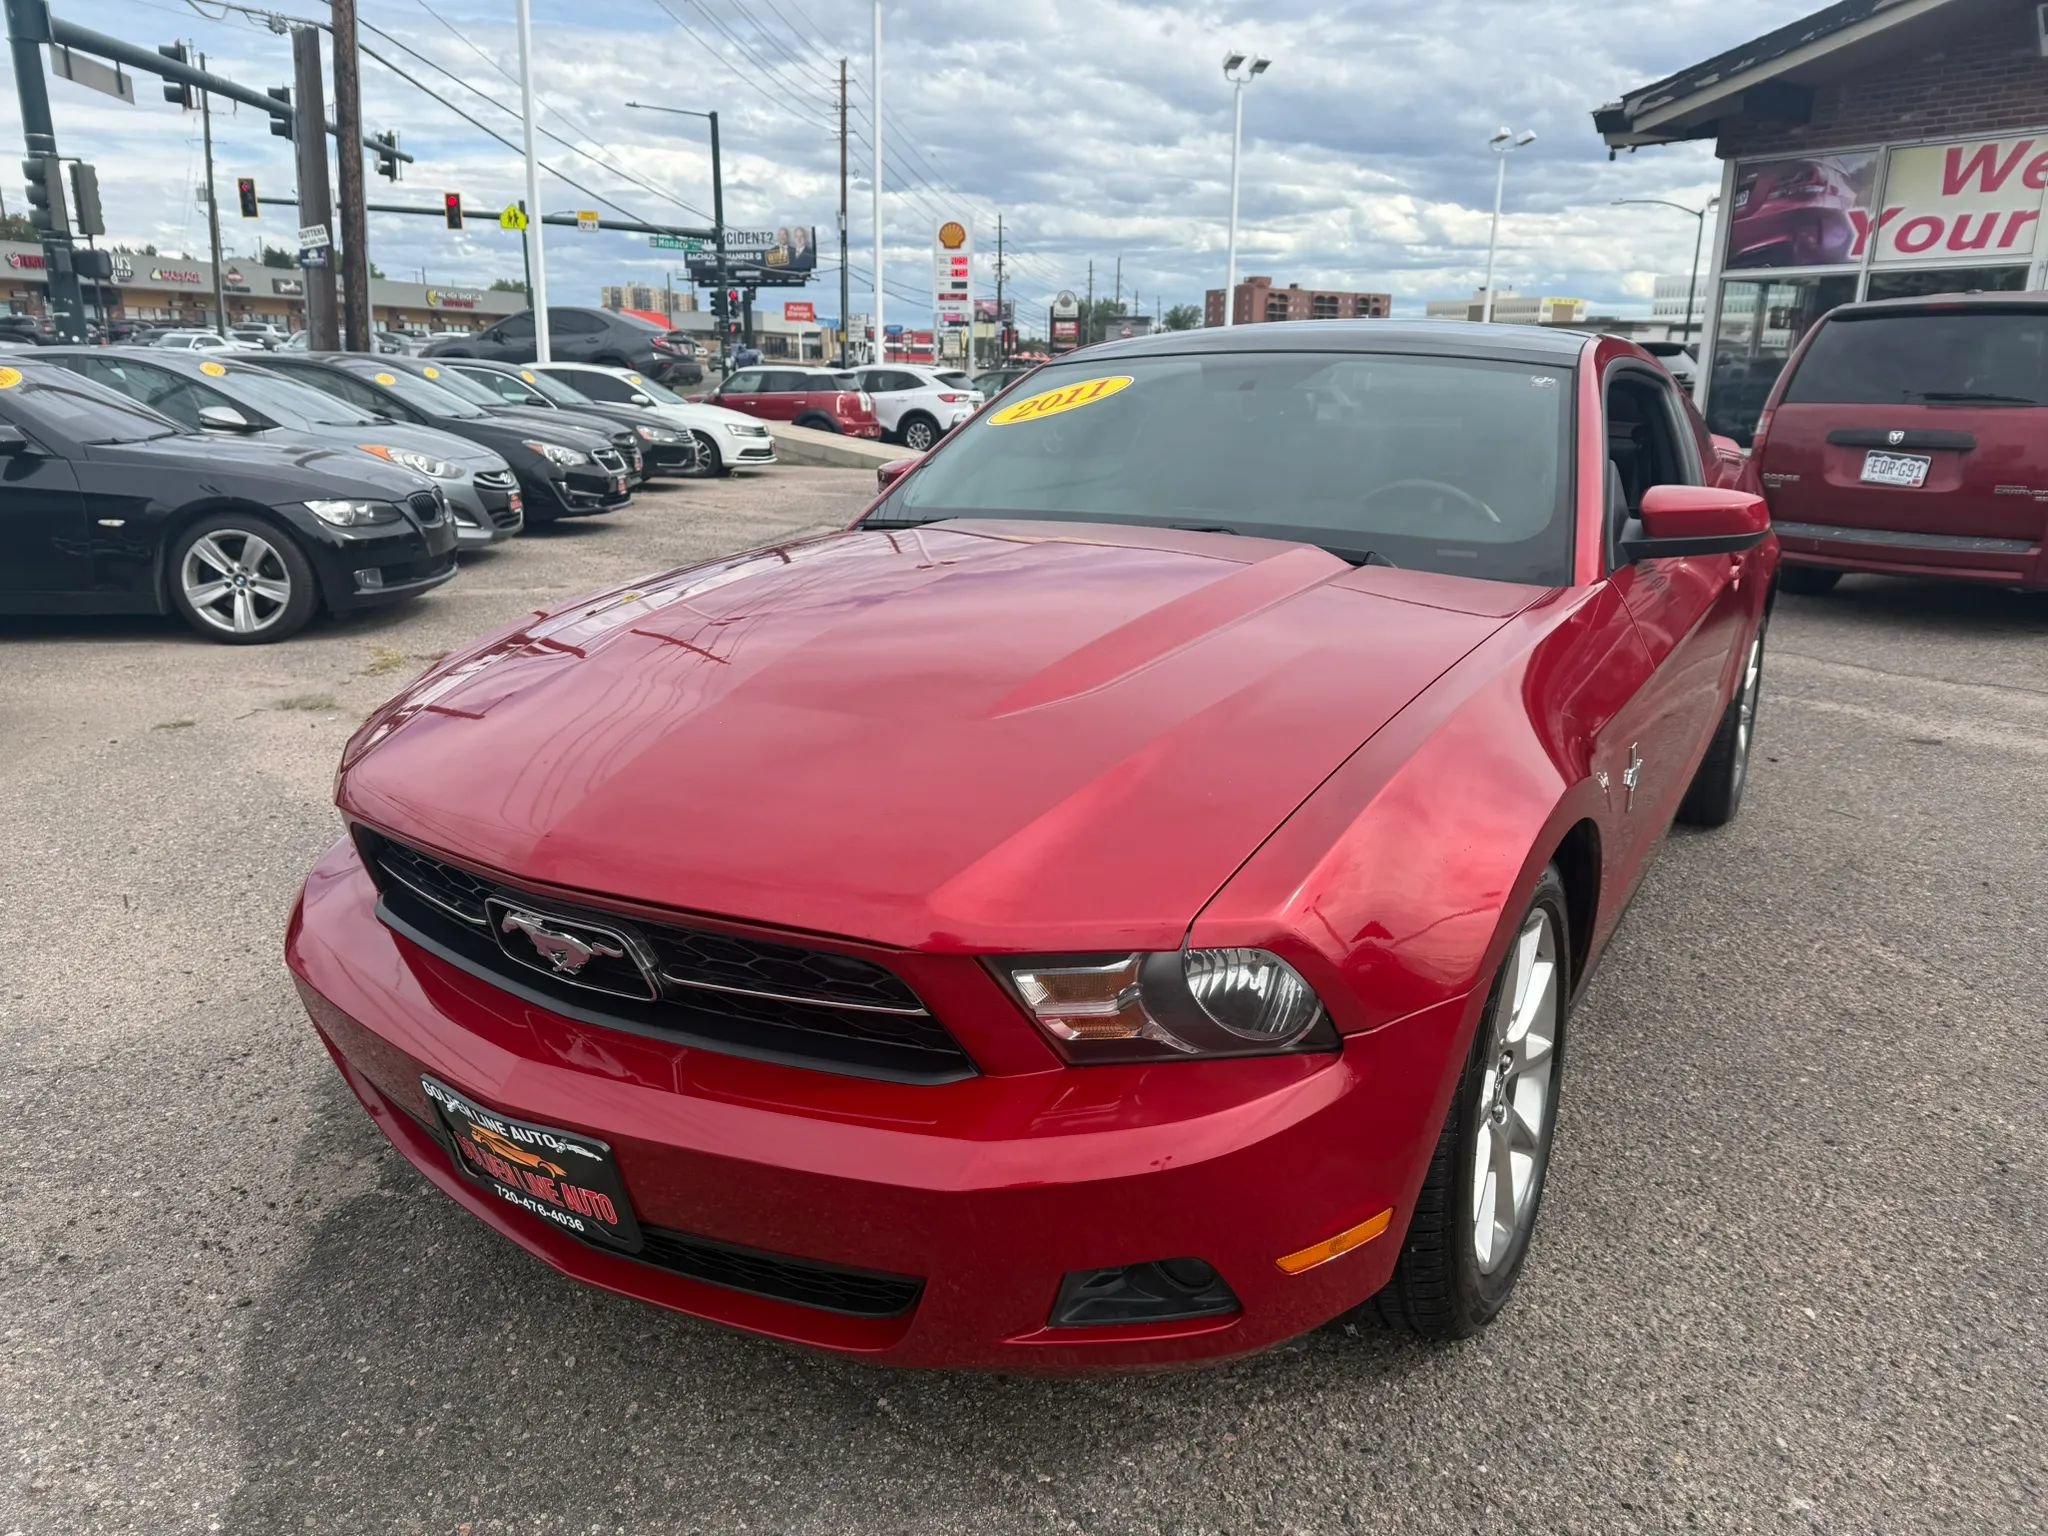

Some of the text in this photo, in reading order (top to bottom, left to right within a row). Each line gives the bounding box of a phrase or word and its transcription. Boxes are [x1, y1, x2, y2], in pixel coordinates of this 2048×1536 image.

[1942, 139, 2048, 196] We
[658, 237, 688, 249] Monaco
[1848, 207, 2040, 257] Your
[1010, 380, 1110, 420] 2011
[472, 1110, 509, 1138] LINE
[509, 1125, 557, 1149] AUTO
[453, 1131, 618, 1225] GOLDEN LINE AUTO
[493, 1183, 585, 1232] 720-476-4036
